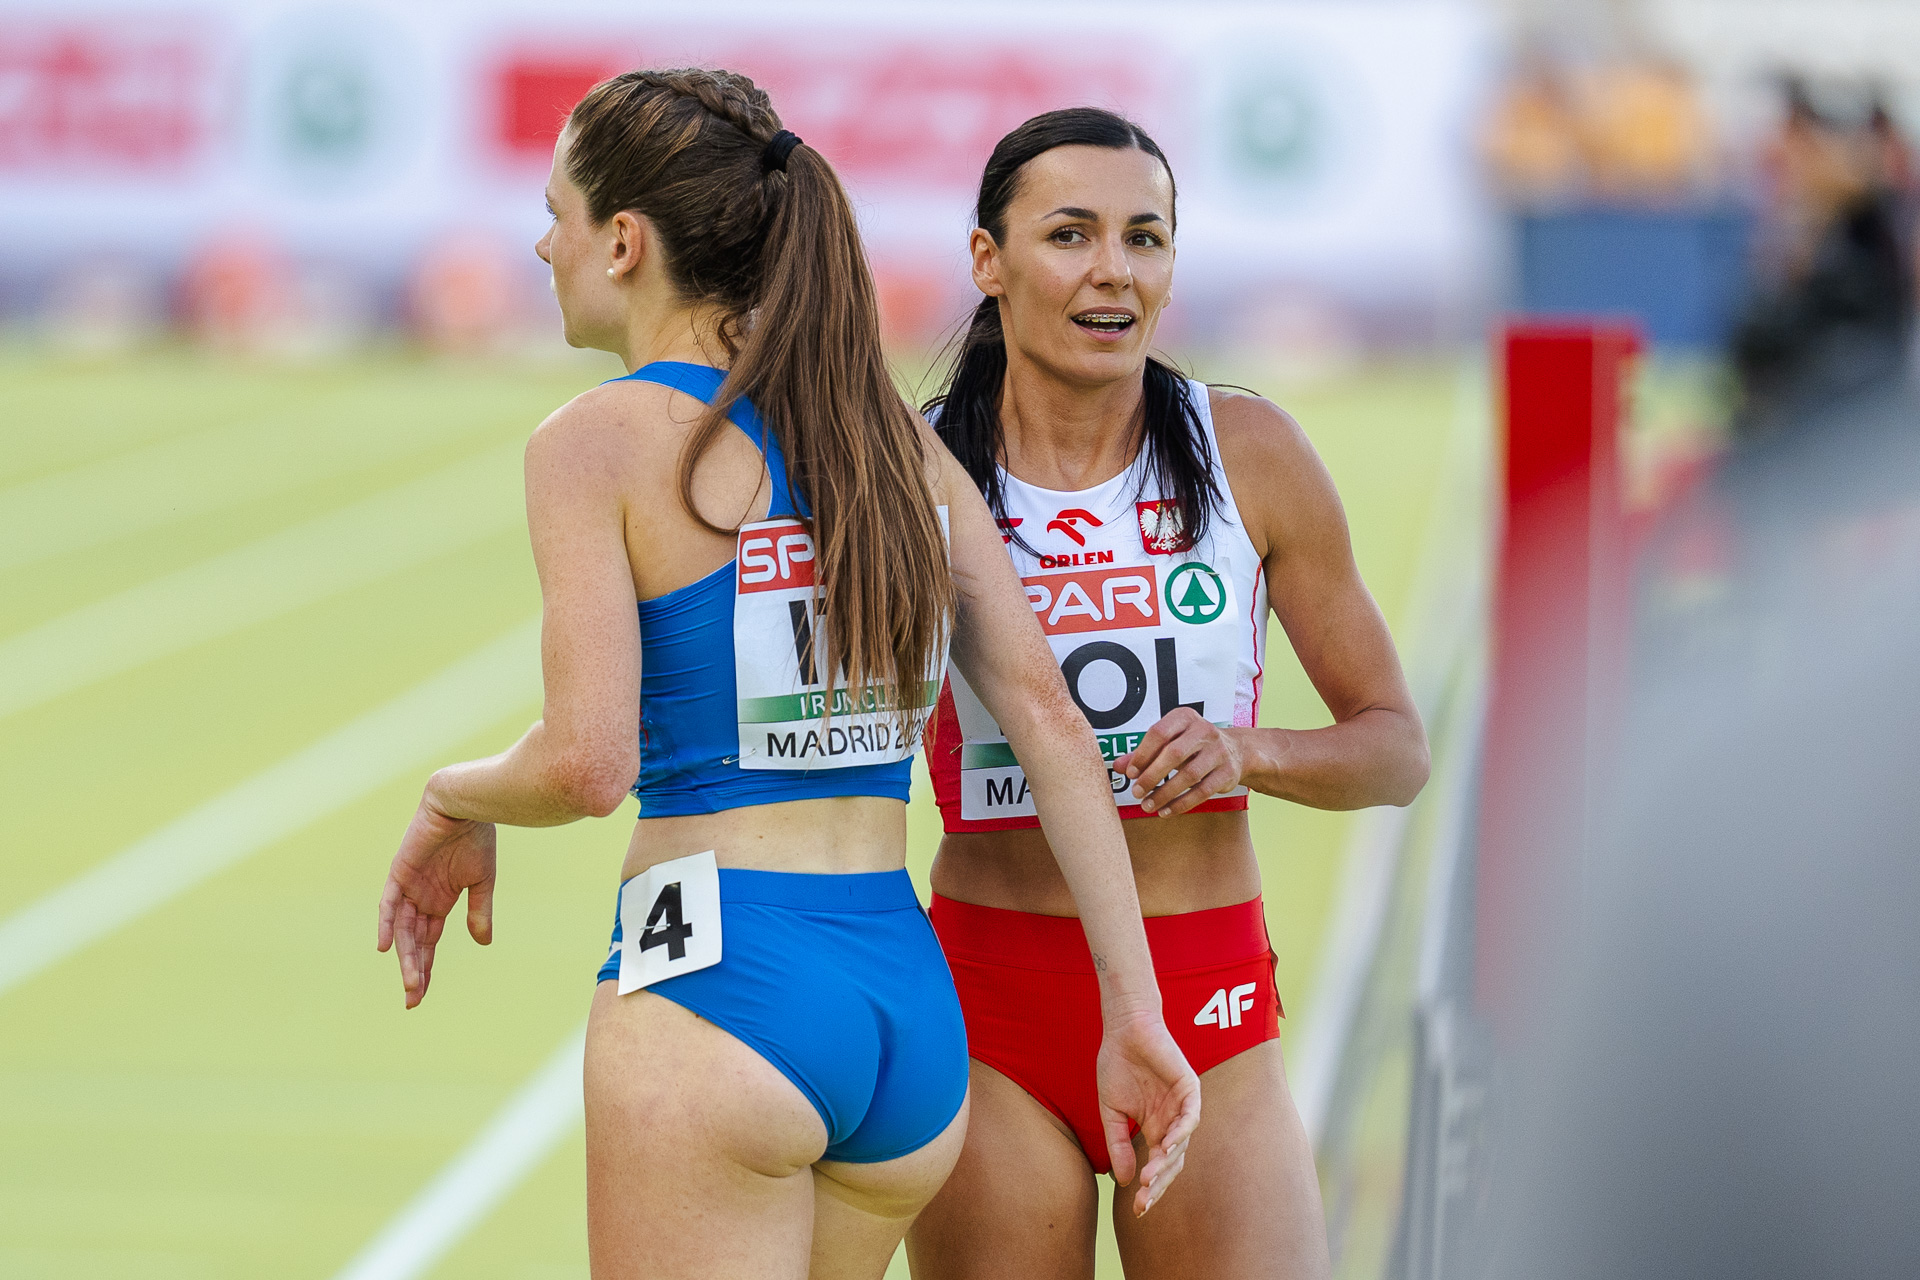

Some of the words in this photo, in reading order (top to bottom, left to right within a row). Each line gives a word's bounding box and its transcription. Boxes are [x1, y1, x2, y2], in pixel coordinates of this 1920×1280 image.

[741, 533, 816, 584] SP
[1039, 550, 1114, 570] ORLEN
[1023, 575, 1154, 627] PAR
[1000, 637, 1205, 736] OL
[767, 723, 890, 758] MADRID
[1097, 735, 1139, 758] CLE
[639, 881, 693, 962] 4
[1194, 981, 1257, 1030] 4F
